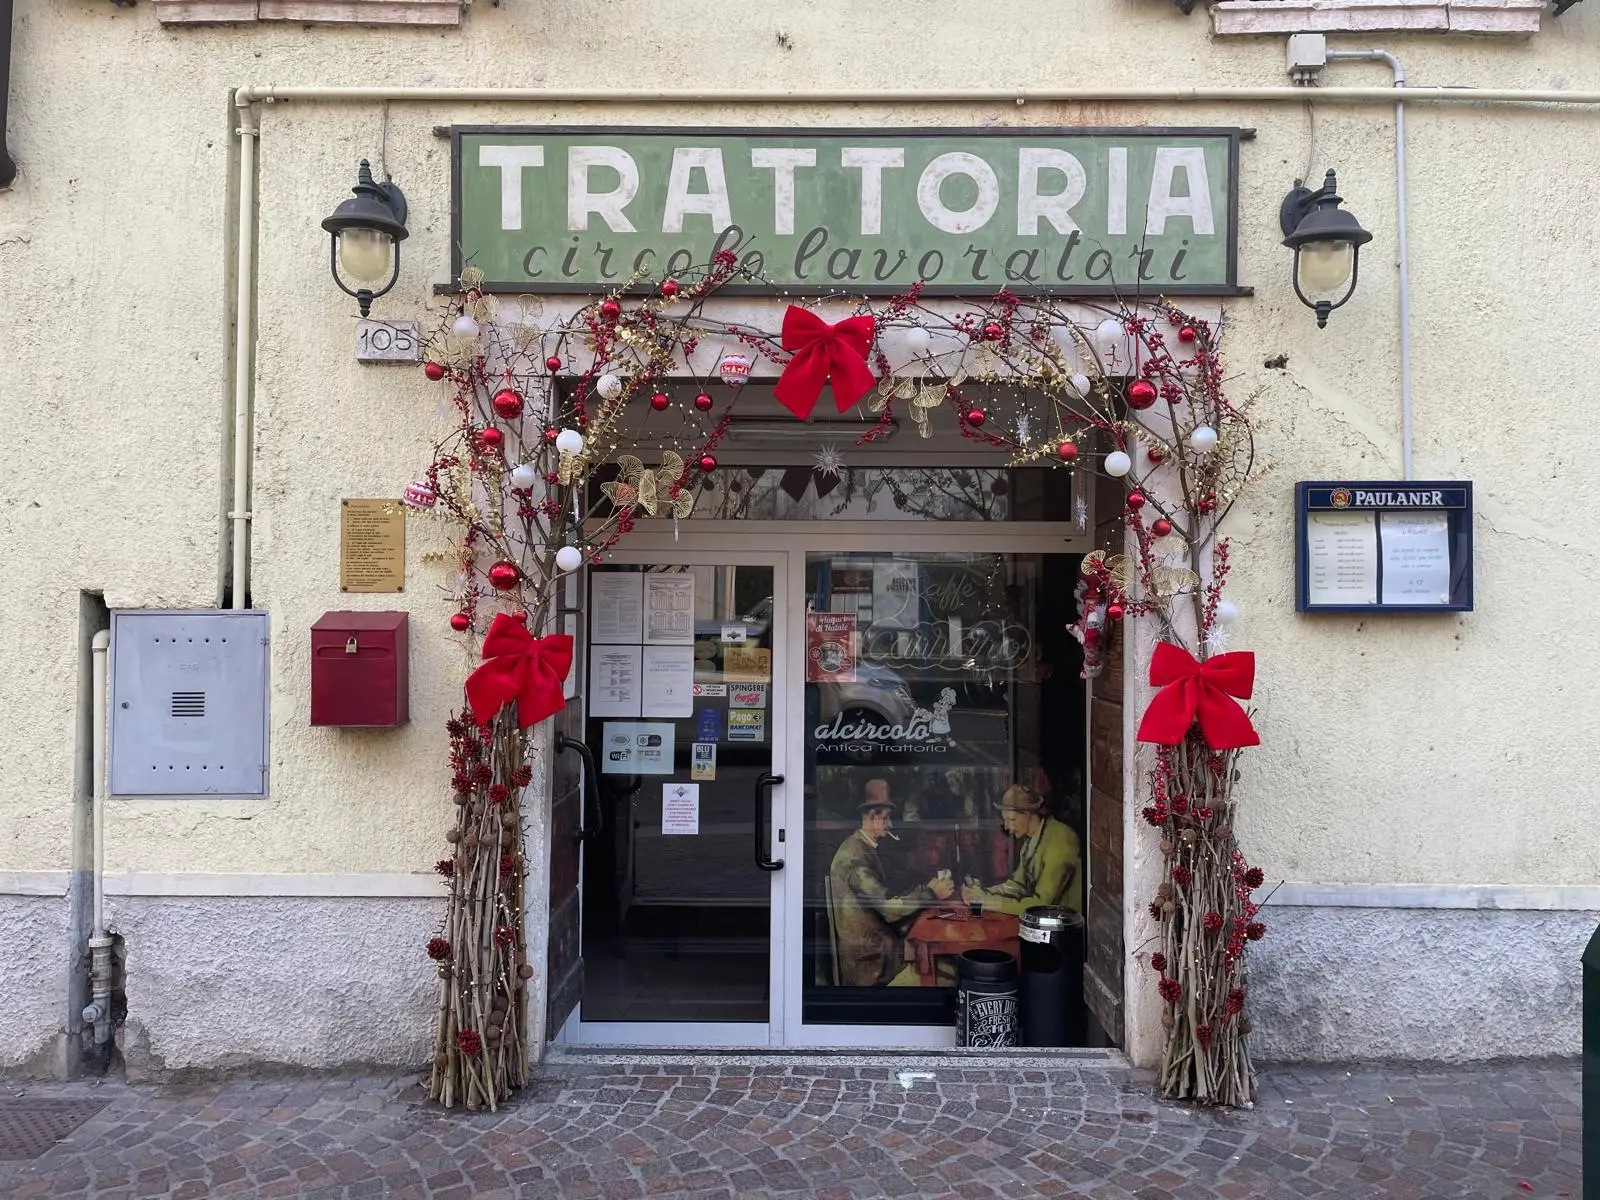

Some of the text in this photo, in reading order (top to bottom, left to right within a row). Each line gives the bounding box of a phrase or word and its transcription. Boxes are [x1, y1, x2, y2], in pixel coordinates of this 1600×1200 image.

[479, 145, 1215, 234] TRATTORIA
[523, 224, 1190, 281] circolo lavoratori
[361, 329, 411, 350] 105
[1355, 491, 1444, 506] PAULANER
[730, 684, 764, 692] SPINGERE
[730, 712, 753, 724] Pago
[814, 710, 930, 740] alcircolo
[815, 743, 946, 753] Antica Trattoria
[976, 1000, 1004, 1017] EVERY
[988, 1015, 1011, 1026] FRESH
